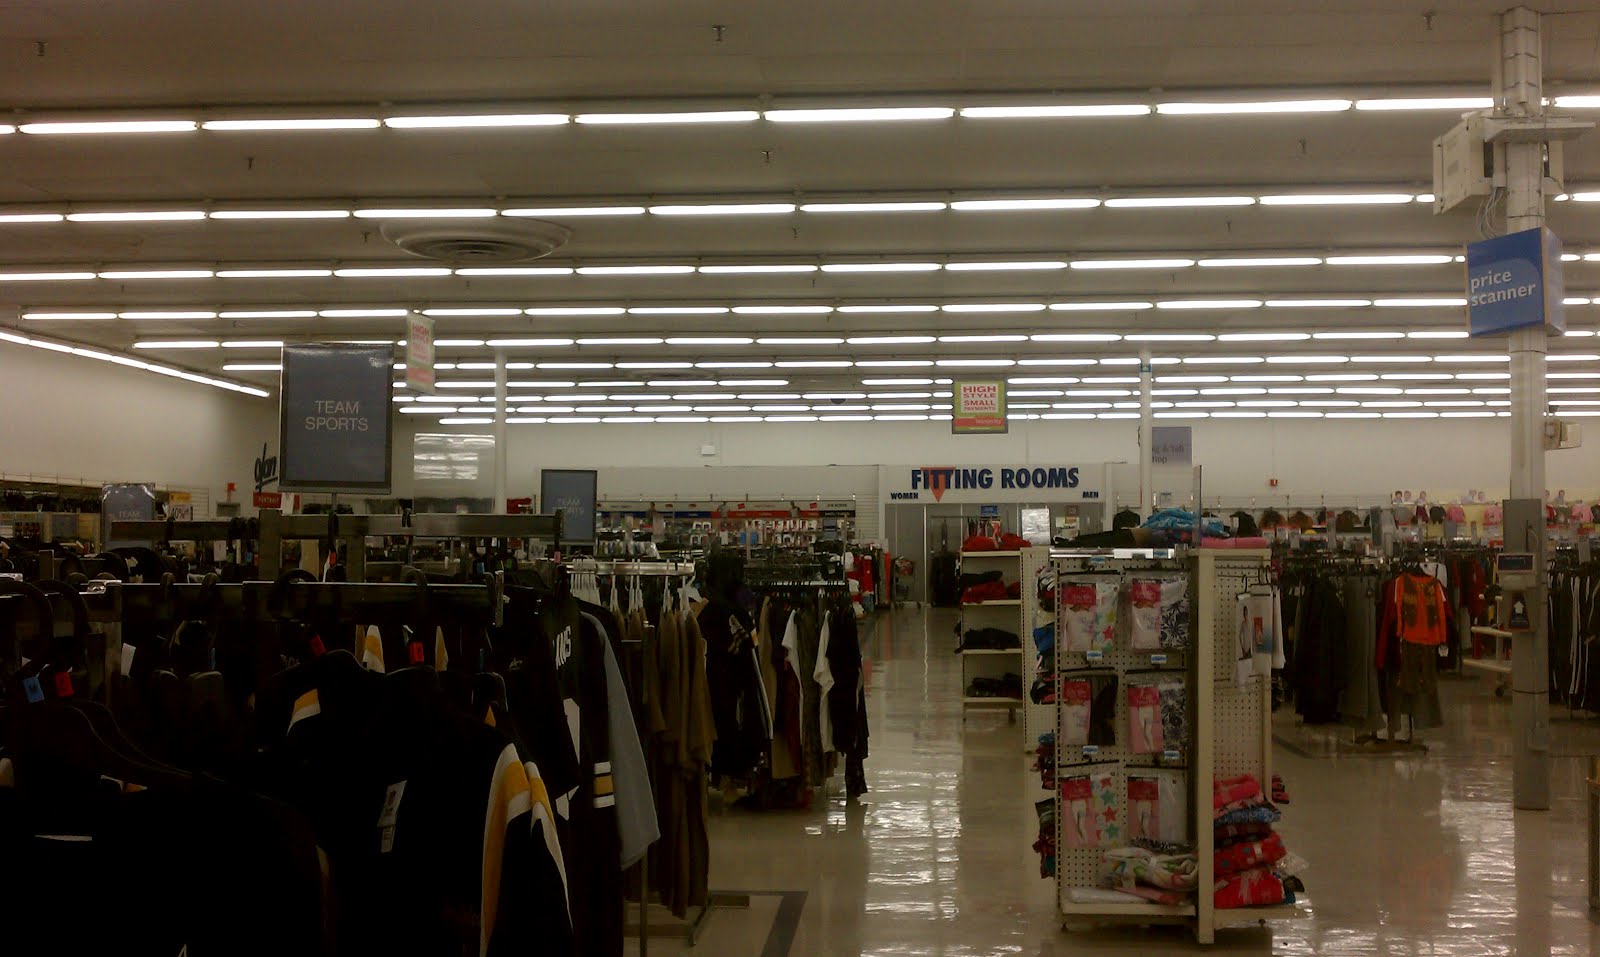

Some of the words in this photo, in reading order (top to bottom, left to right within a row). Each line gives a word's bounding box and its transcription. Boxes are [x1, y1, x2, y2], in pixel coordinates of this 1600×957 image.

[1470, 270, 1512, 293] price
[1471, 284, 1536, 307] scanner
[963, 385, 996, 393] HIGH
[315, 400, 360, 414] TEAM
[304, 416, 369, 431] SPORTS
[911, 468, 994, 490] FITTING
[1001, 467, 1079, 489] ROOMS
[890, 491, 919, 500] WOMEN
